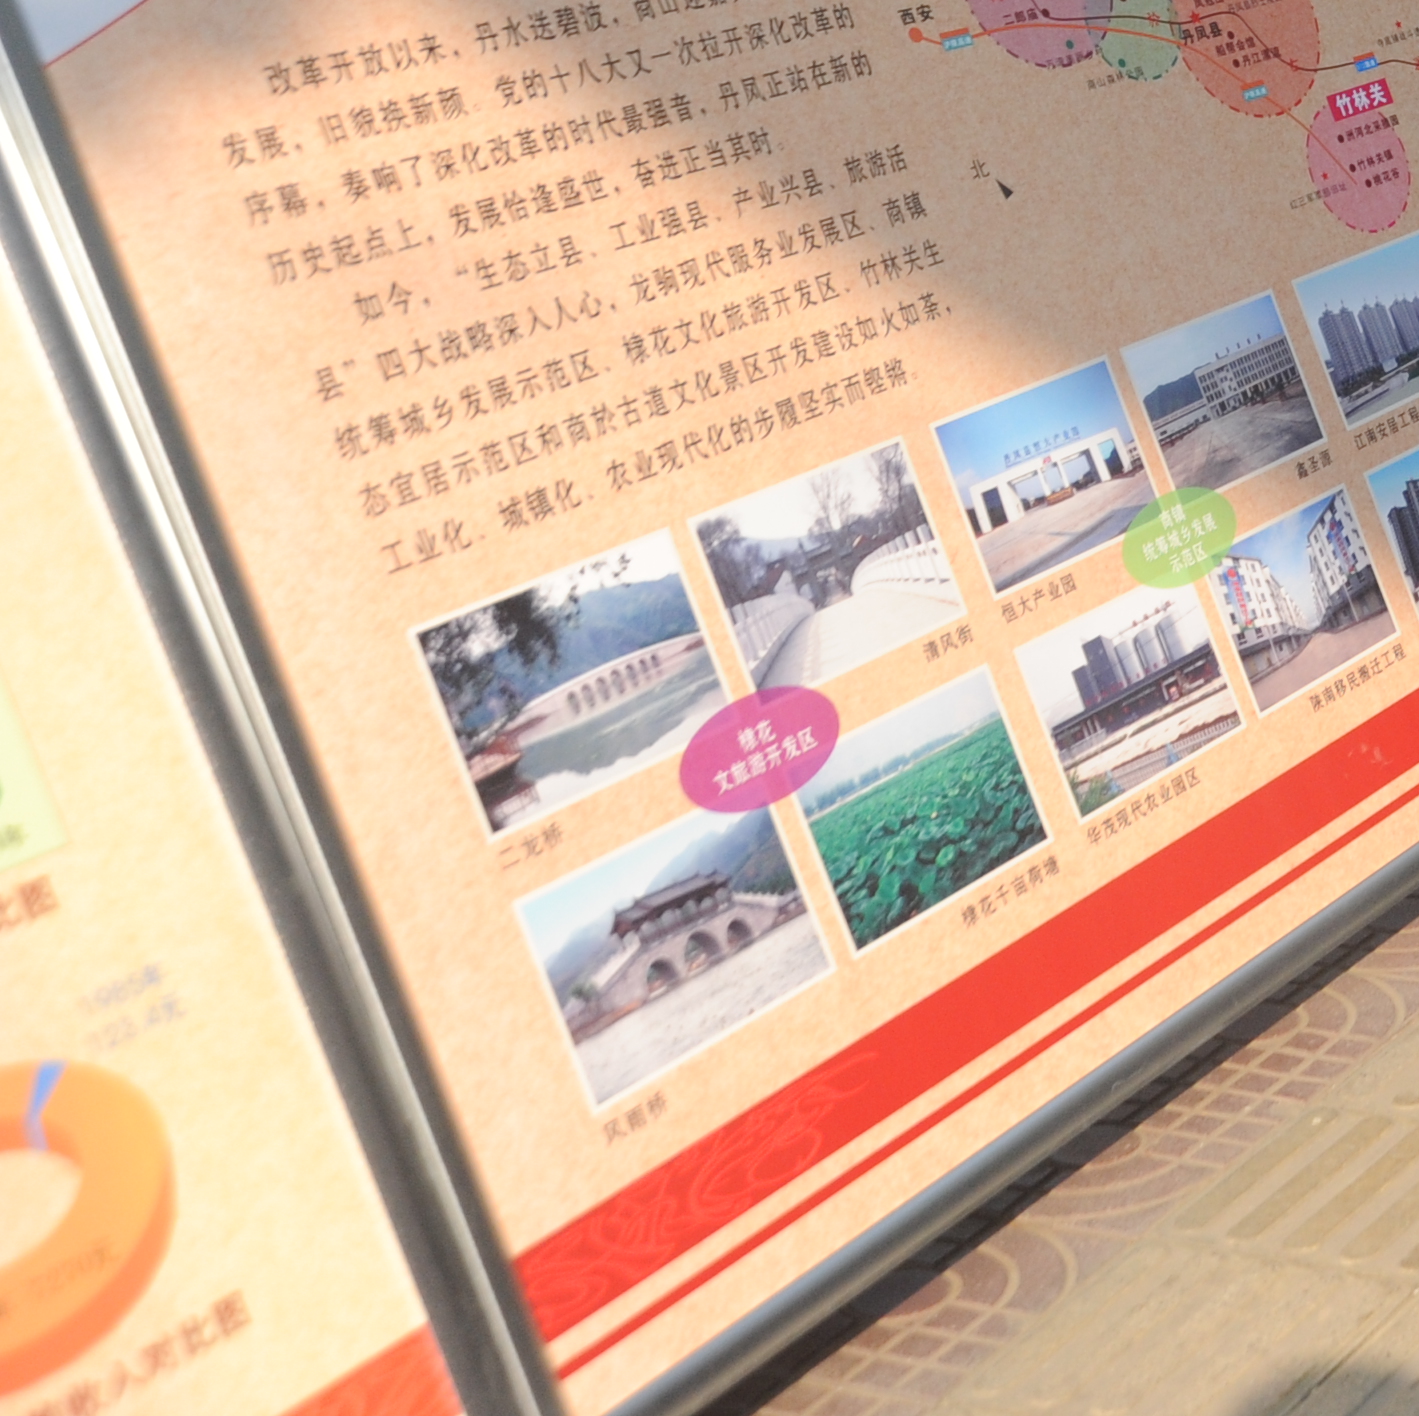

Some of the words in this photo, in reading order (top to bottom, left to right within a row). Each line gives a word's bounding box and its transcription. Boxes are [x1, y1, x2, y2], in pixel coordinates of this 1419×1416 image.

[897, 3, 935, 27] 西安
[1180, 21, 1224, 47] 丹凤县
[1334, 83, 1389, 119] 竹林关
[970, 157, 991, 181] 北
[1000, 572, 1078, 625] 恒大产业园
